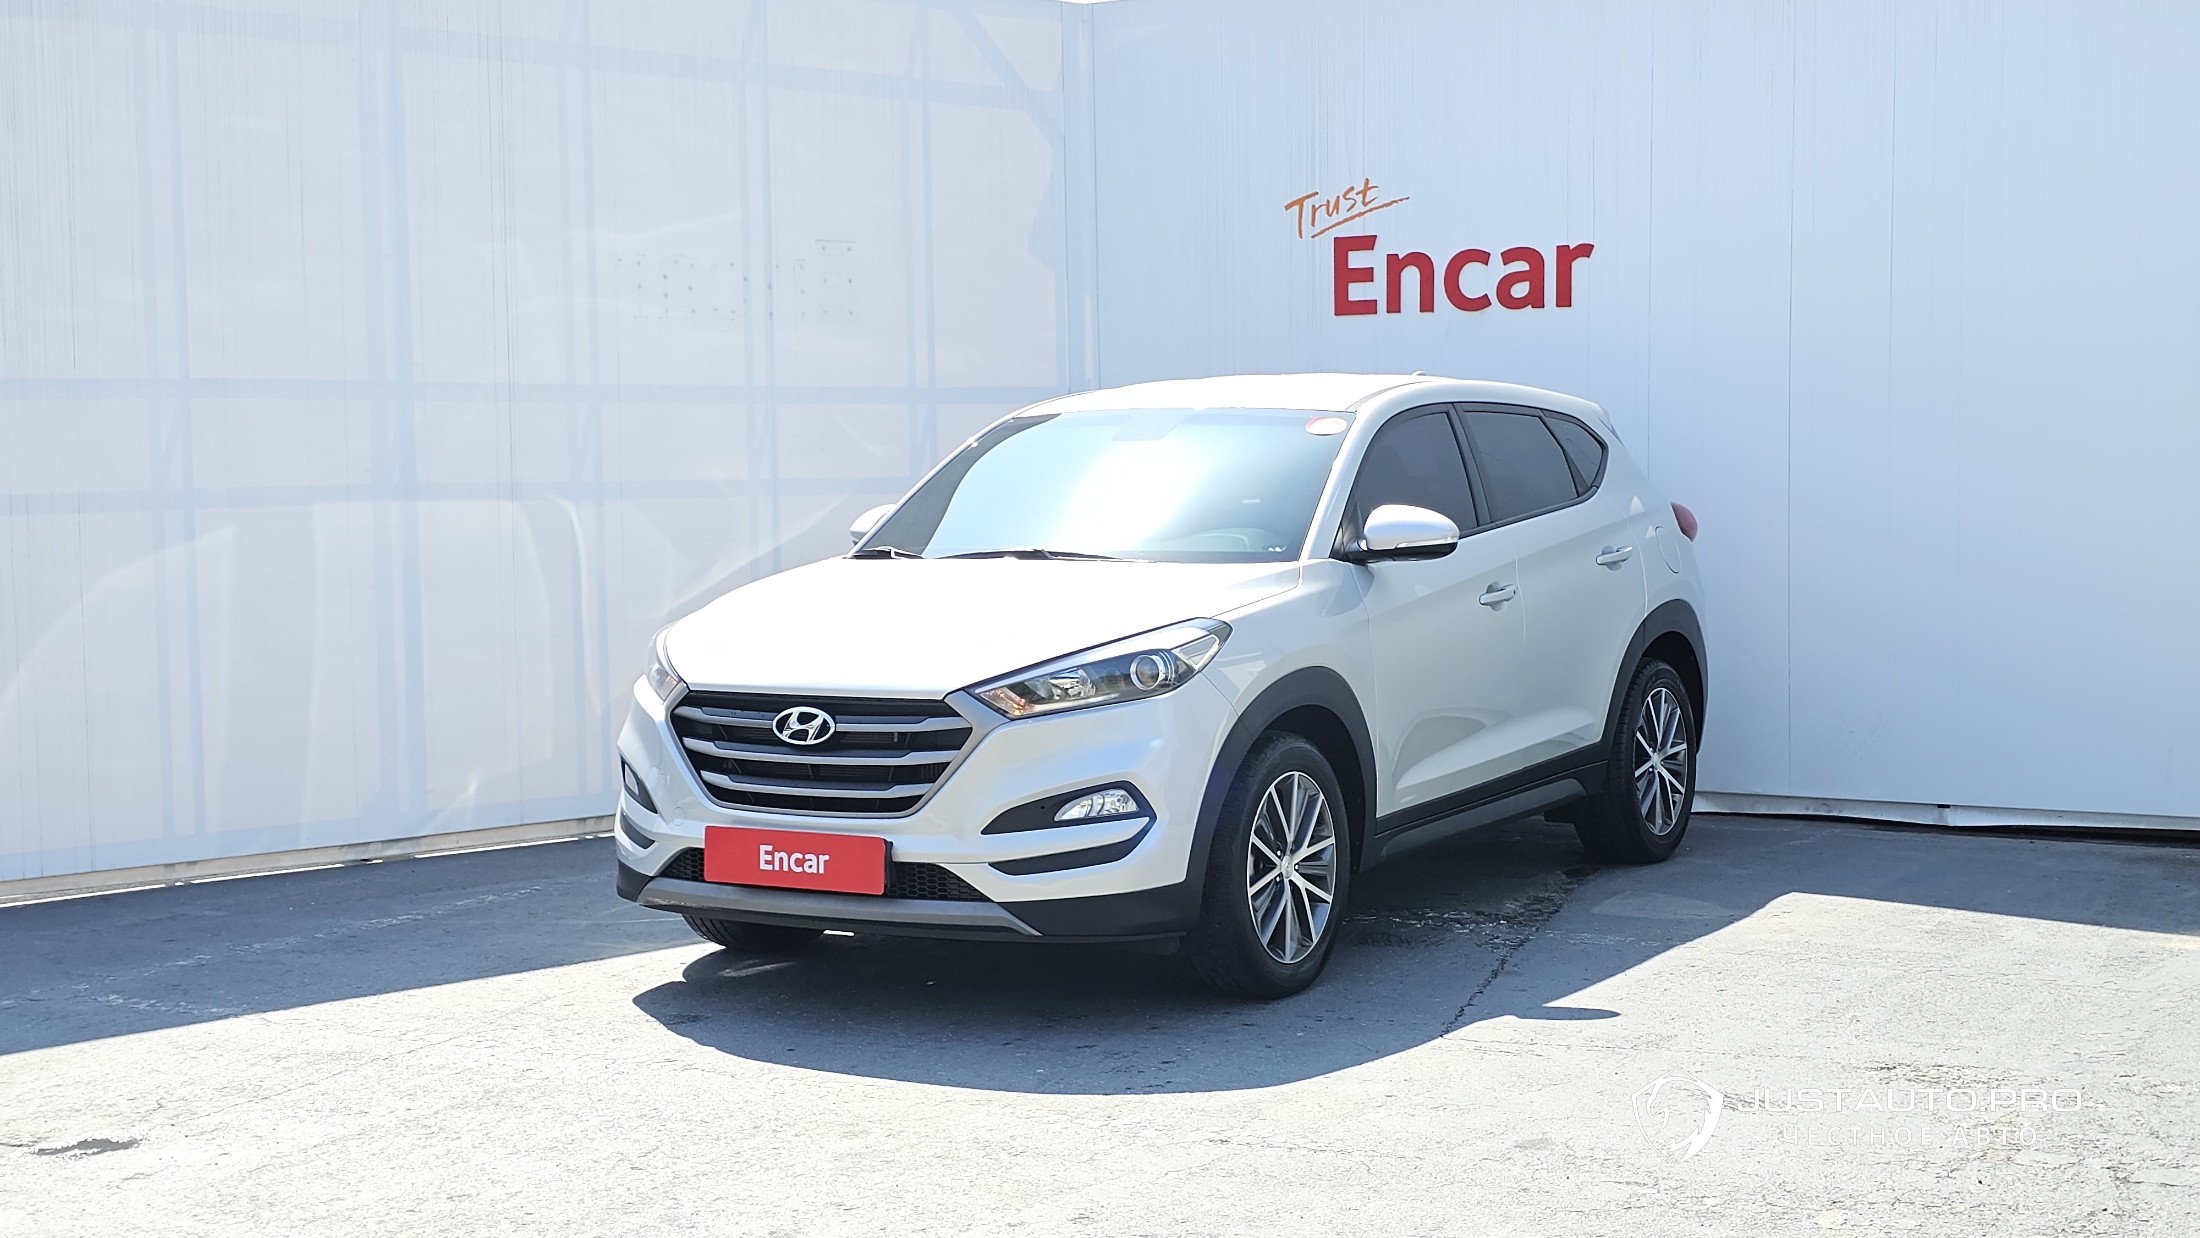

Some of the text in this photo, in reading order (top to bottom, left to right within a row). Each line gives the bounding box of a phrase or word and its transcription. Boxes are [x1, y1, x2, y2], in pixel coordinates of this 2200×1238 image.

[1284, 177, 1379, 239] Trust
[1333, 234, 1595, 316] Encar
[759, 844, 830, 874] Encar
